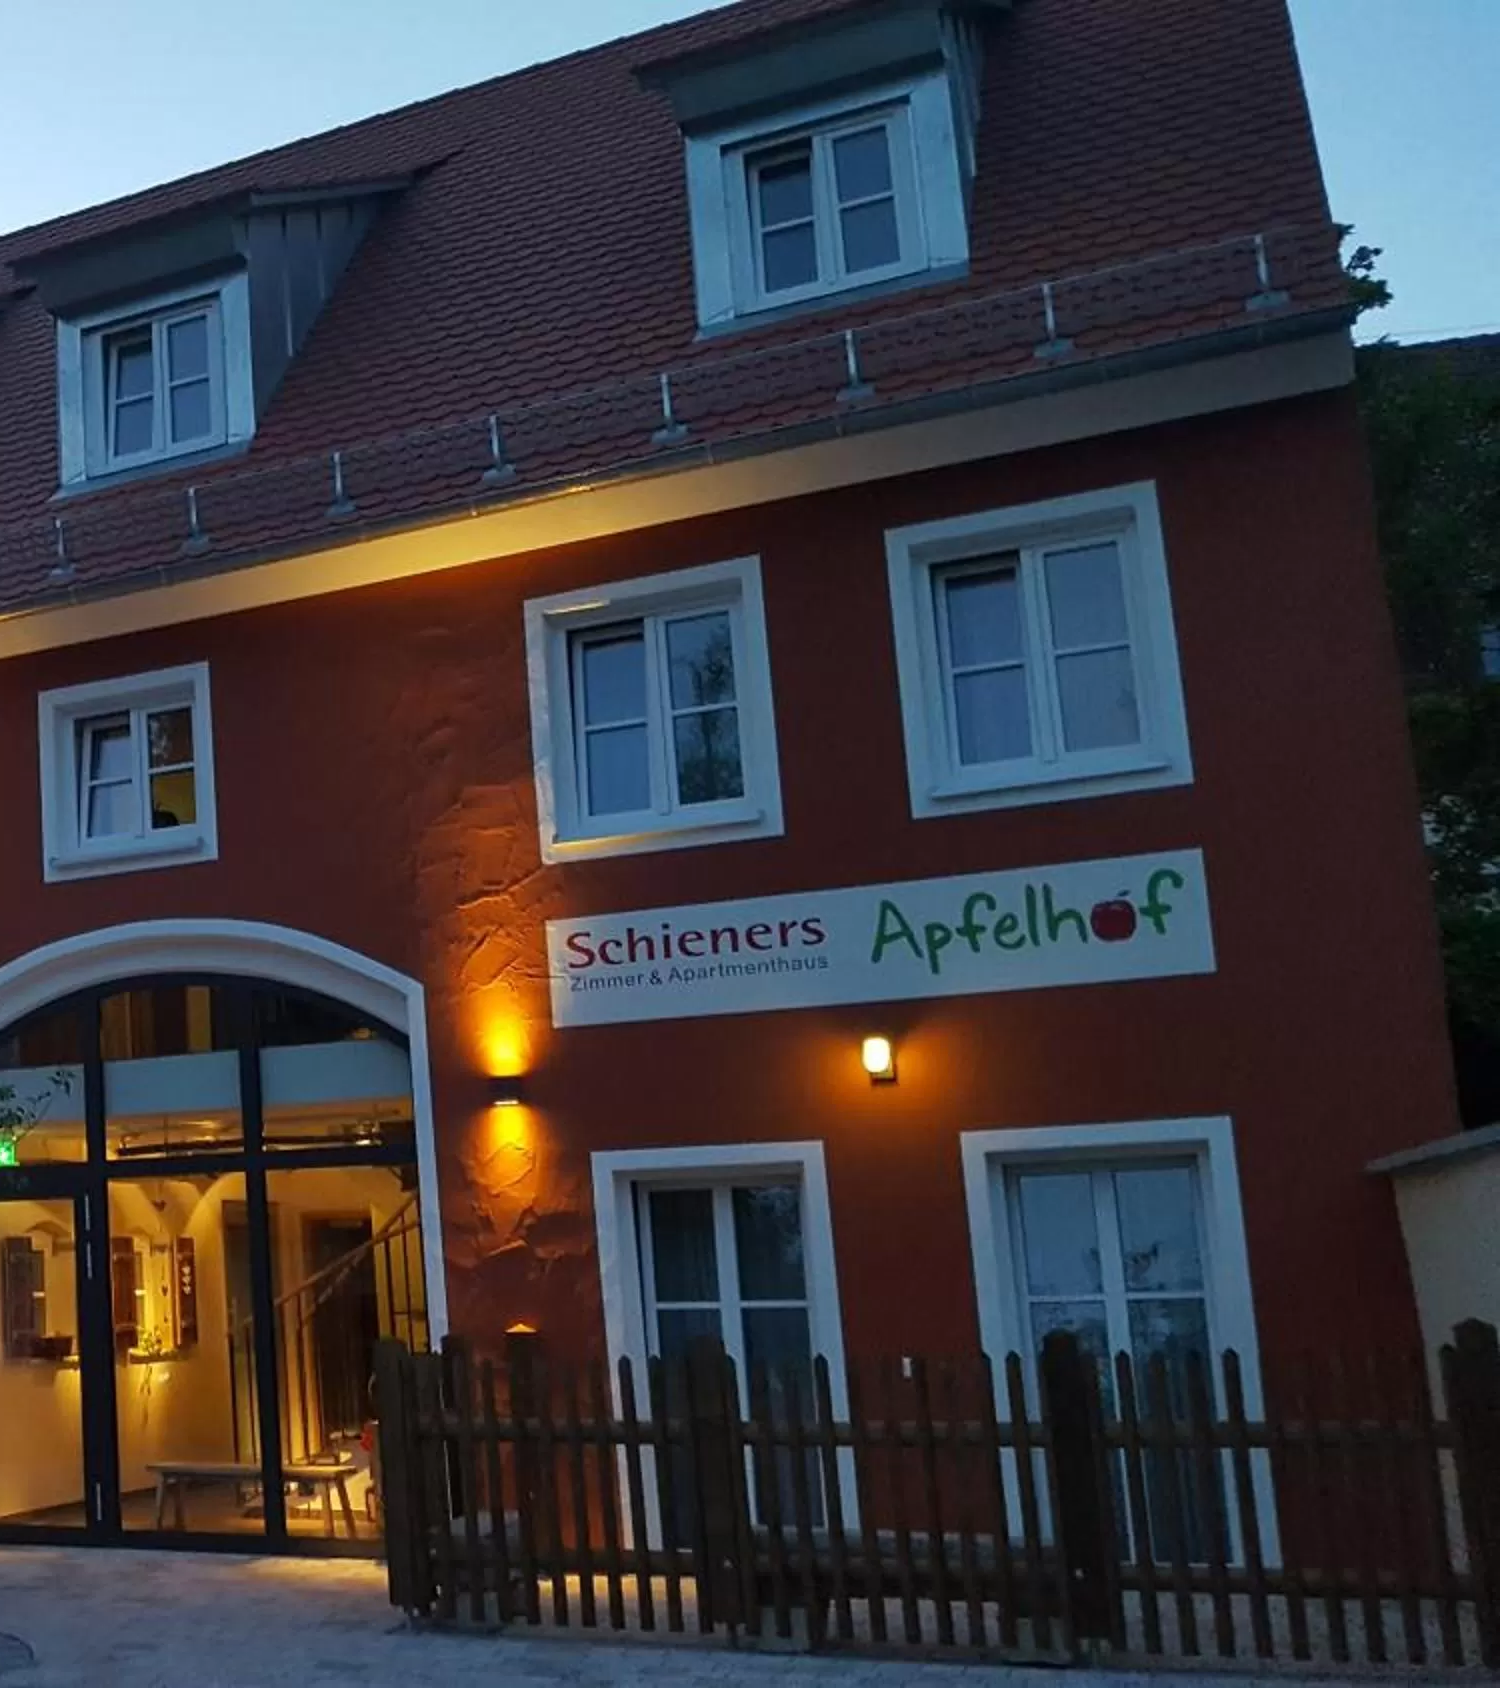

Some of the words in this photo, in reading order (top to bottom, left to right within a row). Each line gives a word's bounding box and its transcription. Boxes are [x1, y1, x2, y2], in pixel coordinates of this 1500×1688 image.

[566, 917, 827, 969] Schieners
[870, 868, 1185, 975] Apfelhof
[570, 974, 644, 993] Zimmer
[649, 969, 663, 986] &
[668, 955, 830, 984] Apartmenthaus
